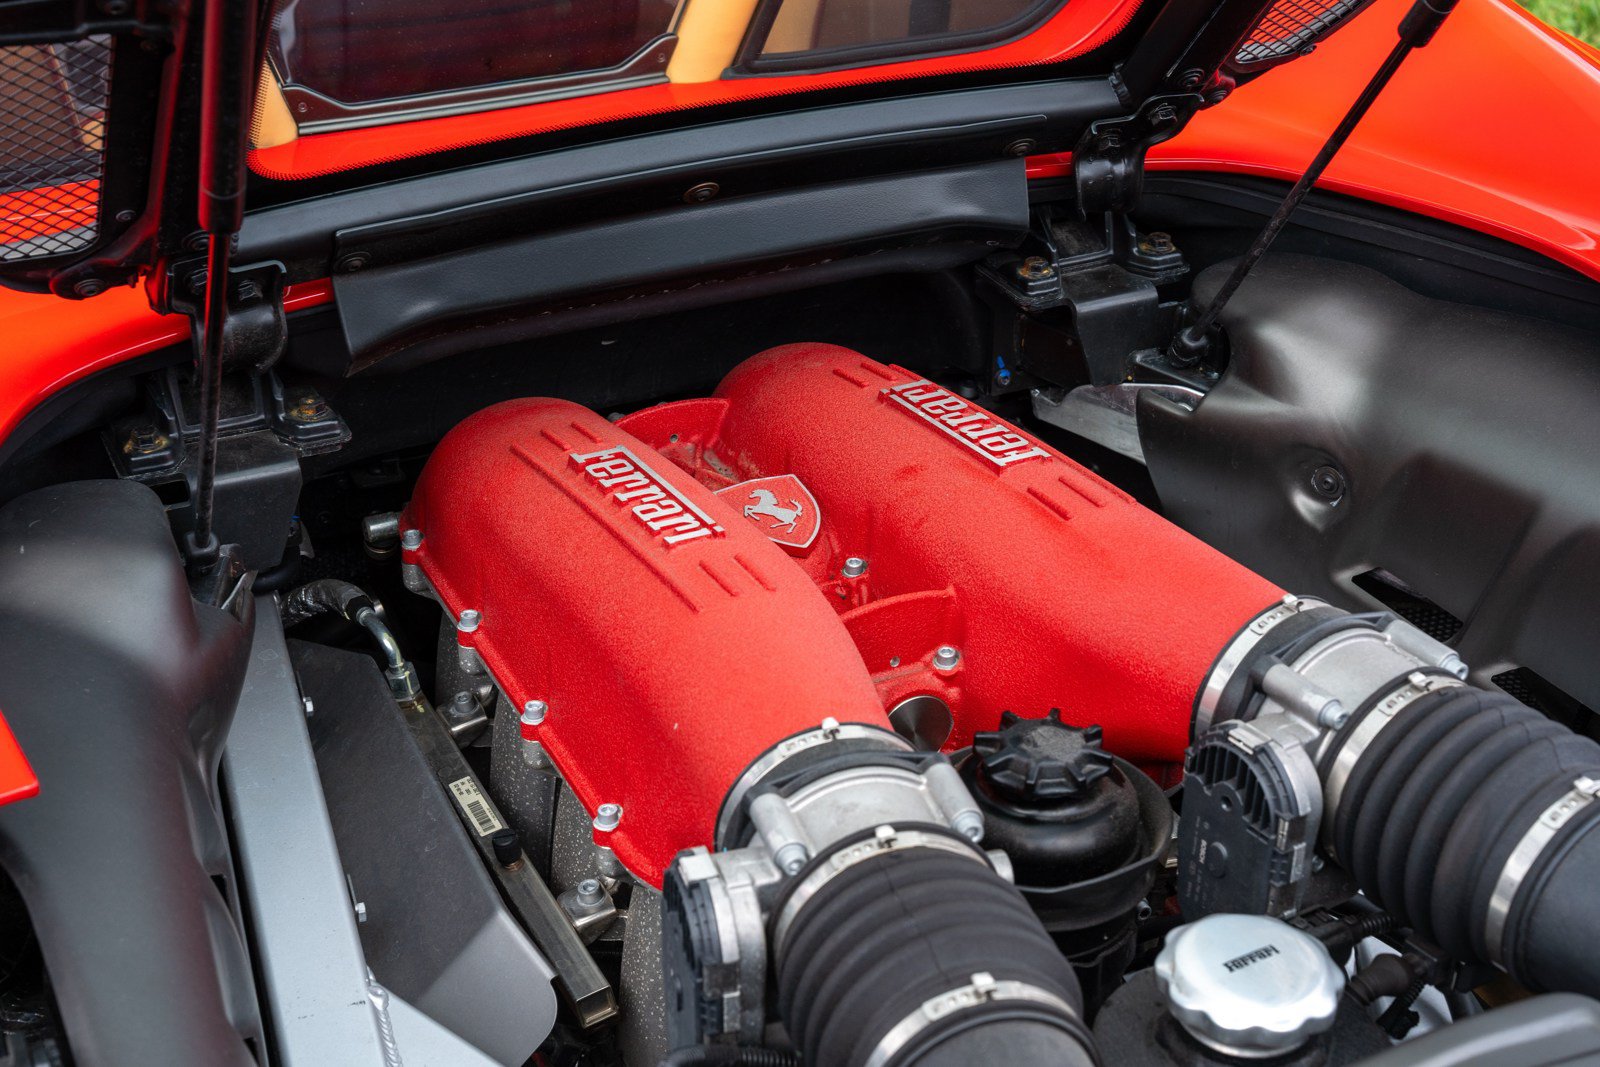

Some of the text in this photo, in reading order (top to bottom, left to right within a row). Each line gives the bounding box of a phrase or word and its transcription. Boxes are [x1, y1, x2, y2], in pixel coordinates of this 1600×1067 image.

[880, 379, 1052, 467] Ferrari
[569, 444, 726, 545] Ferrari
[1199, 838, 1208, 865] BOSCH
[1222, 943, 1280, 973] Ferrari
